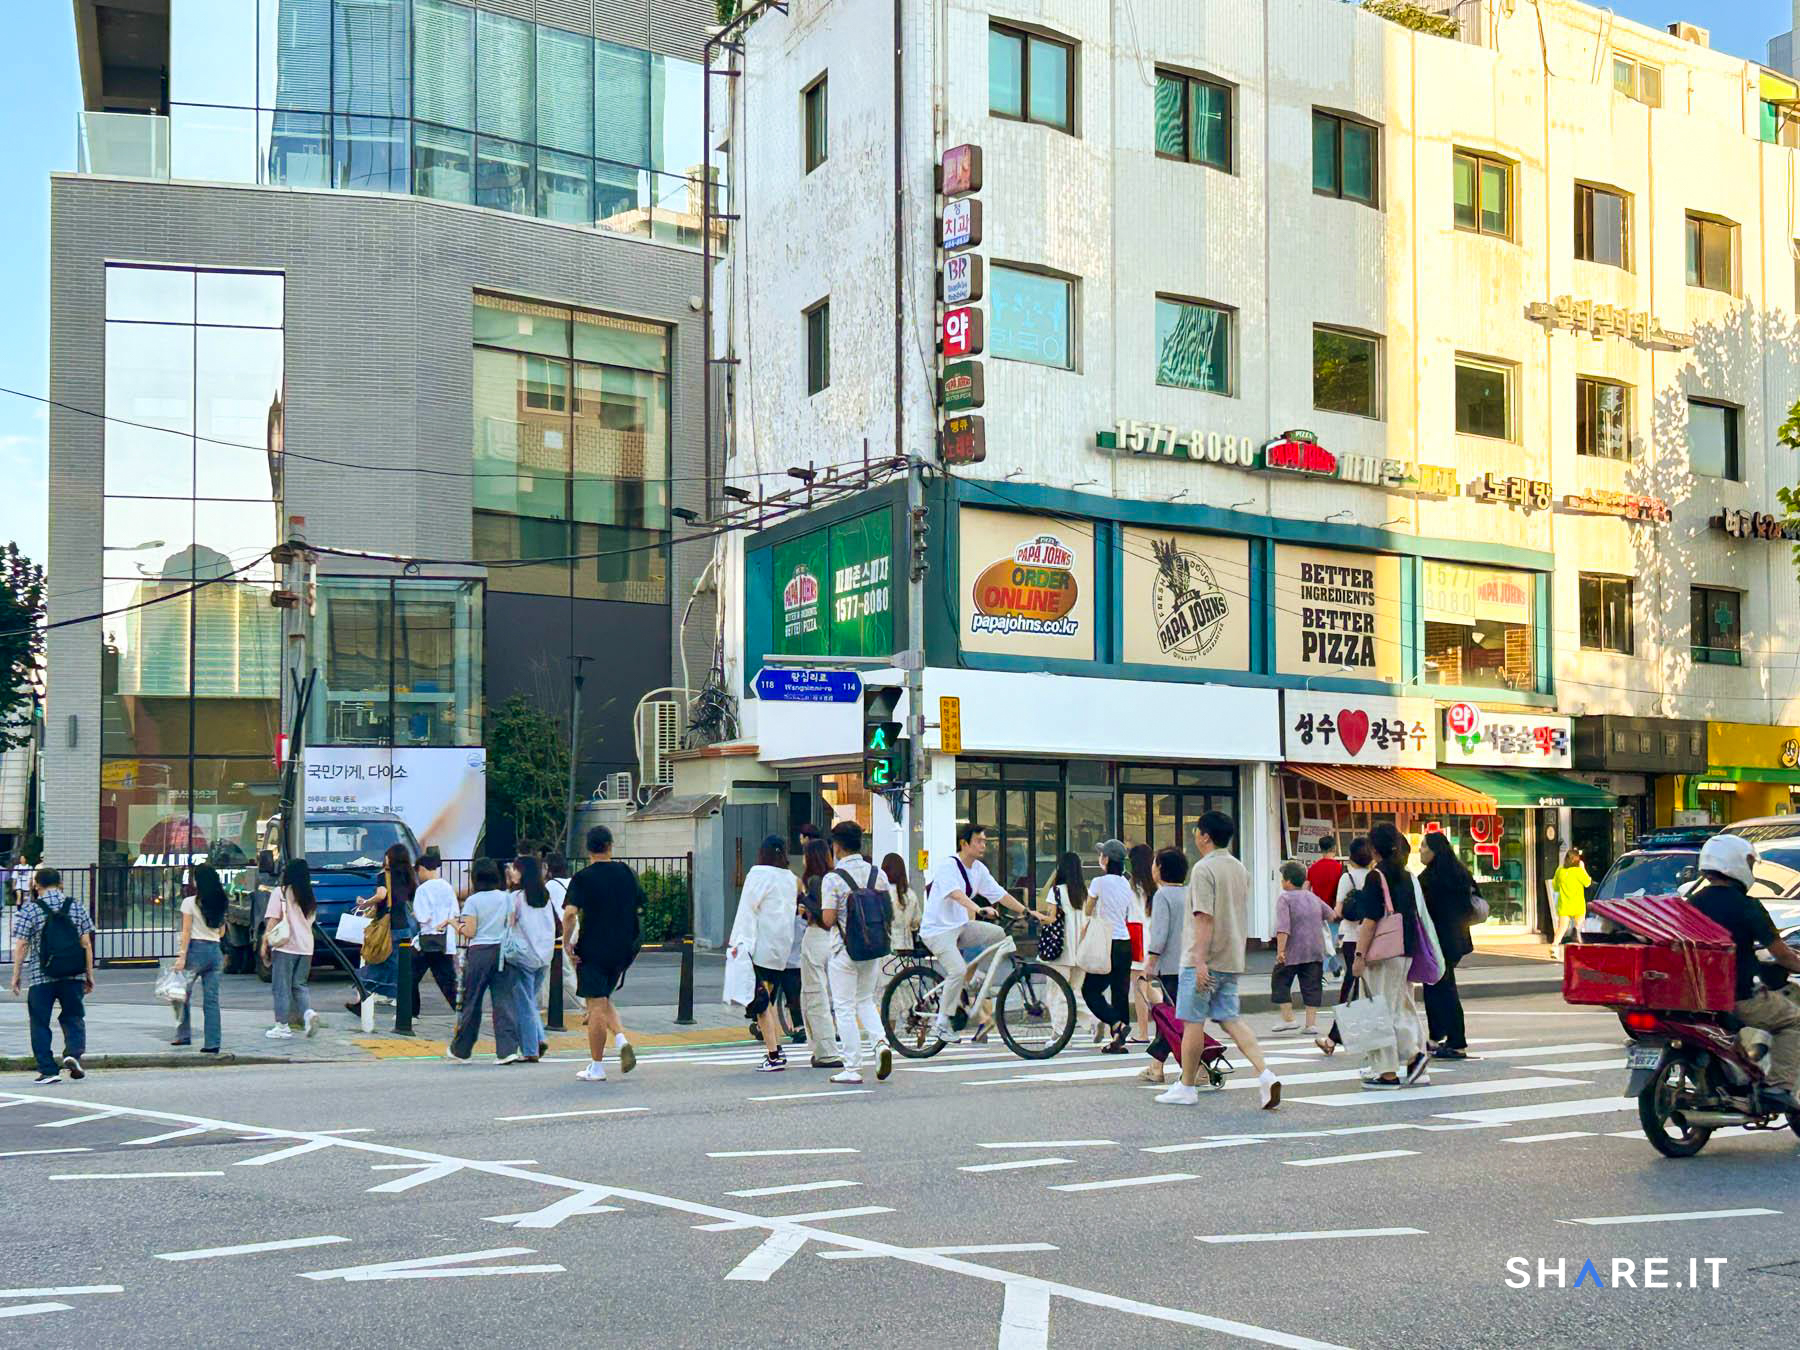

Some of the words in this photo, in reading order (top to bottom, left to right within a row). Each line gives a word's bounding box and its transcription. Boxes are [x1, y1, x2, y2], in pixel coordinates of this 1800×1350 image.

[944, 213, 969, 237] 치과
[949, 257, 967, 281] BR
[946, 312, 969, 350] 약
[1116, 419, 1254, 467] 1577-8080
[1485, 472, 1553, 511] 노래방
[1017, 545, 1041, 562] PAPA
[1042, 546, 1072, 566] JOHNS
[1012, 567, 1070, 590] ORDER
[1301, 562, 1374, 589] BETTER
[835, 587, 889, 623] 1577-8080
[984, 586, 1062, 612] ONLINE
[1301, 585, 1375, 606] INGREDIENTS
[972, 613, 1077, 634] papajohns.co.kr
[1160, 611, 1191, 650] PAPA
[1188, 596, 1227, 631] JOHNS
[1302, 607, 1374, 634] BETTER
[1302, 630, 1376, 667] PIZZA
[761, 681, 775, 689] 118
[1294, 712, 1336, 746] 성수
[1370, 717, 1428, 752] 칼국수
[1452, 706, 1472, 733] 약
[307, 764, 365, 780] 국민가게,
[368, 764, 409, 780] 다이소
[873, 760, 889, 784] 12
[1469, 813, 1504, 870] 약
[133, 853, 167, 867] ALL
